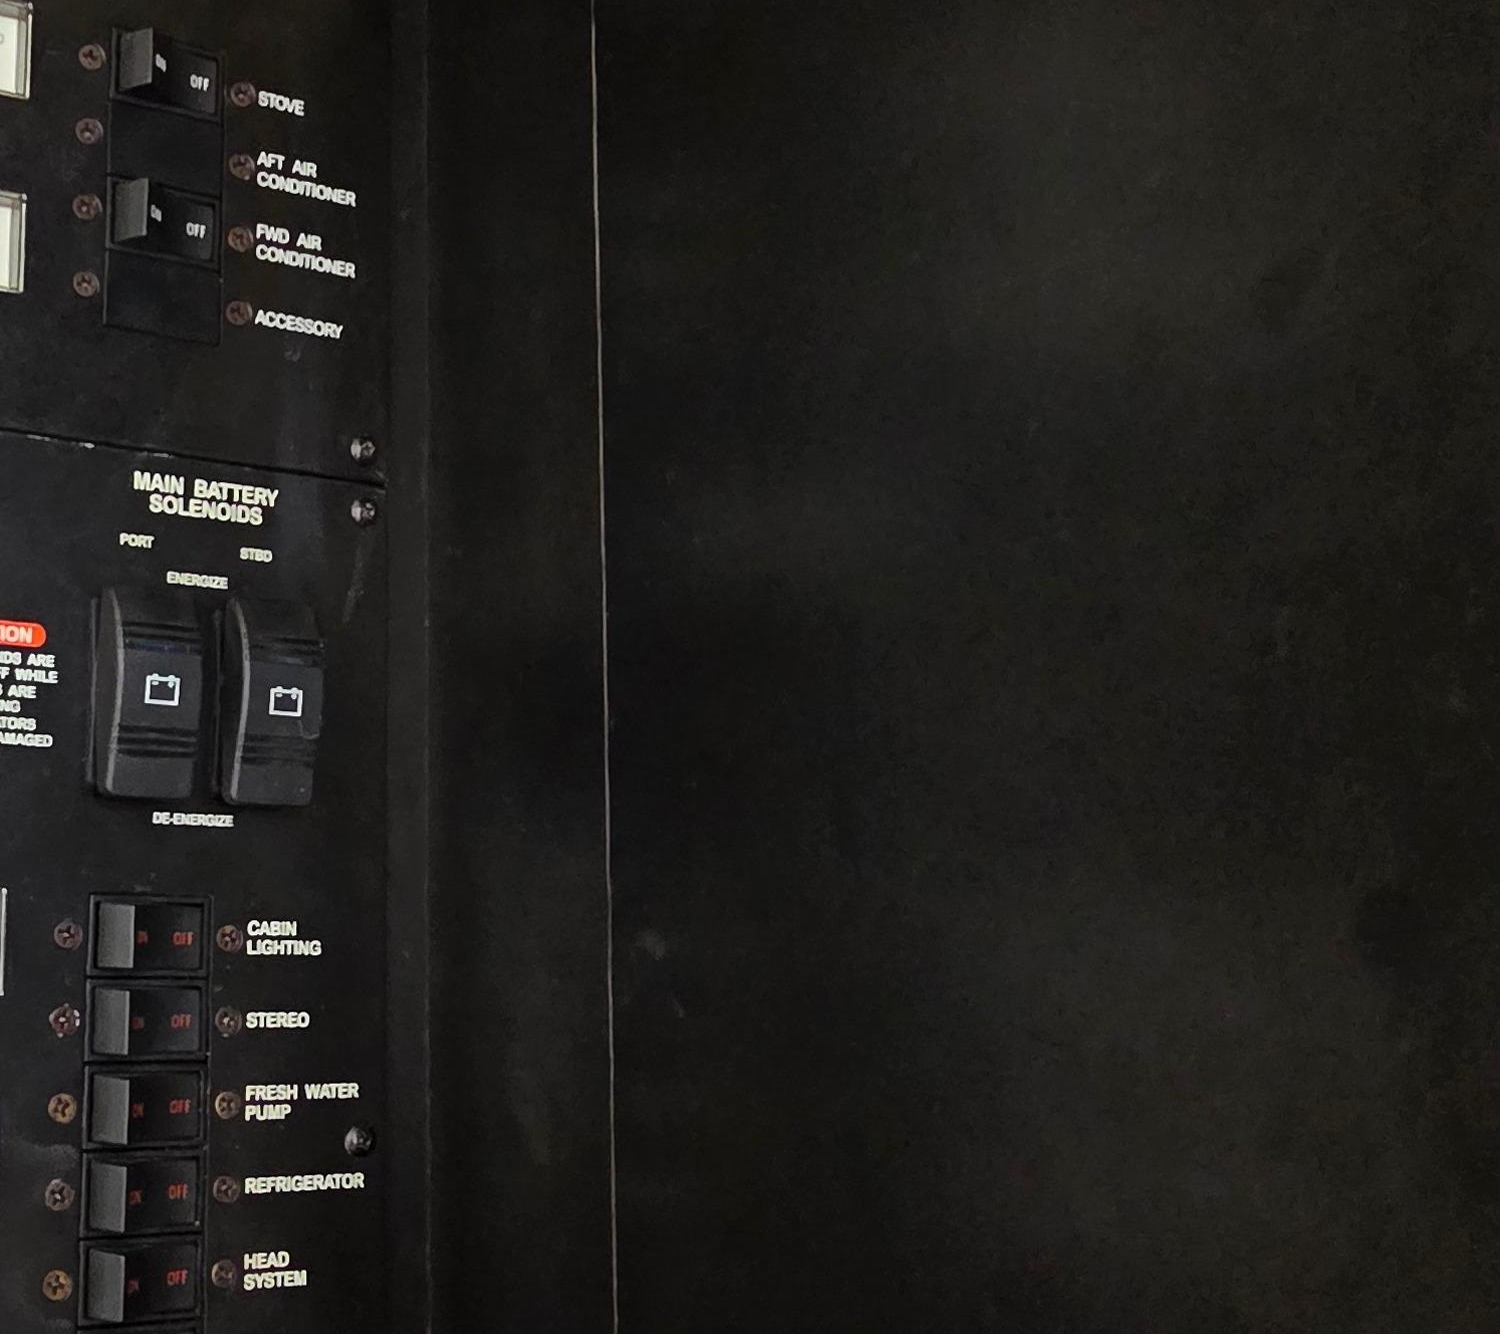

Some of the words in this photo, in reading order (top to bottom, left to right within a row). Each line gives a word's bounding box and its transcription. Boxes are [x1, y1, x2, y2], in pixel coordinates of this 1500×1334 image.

[258, 91, 304, 116] STOVE
[256, 152, 285, 170] AFT
[292, 160, 317, 178] AIR
[257, 172, 356, 207] CONDITIONER
[255, 224, 289, 244] FWD
[296, 233, 321, 251] AIR
[256, 245, 355, 278] CONDITIONER
[254, 310, 343, 339] ACCESSORY
[134, 471, 184, 498] MAIN
[194, 479, 278, 507] BATTERY
[149, 494, 262, 525] SOLENOIDS
[120, 533, 154, 548] PORT
[240, 547, 272, 562] STBD
[167, 571, 228, 589] ENERGIZE
[152, 812, 234, 827] DE-ENERGIZE
[247, 920, 297, 936] CABIN
[247, 939, 321, 955] LIGHTING
[246, 1012, 309, 1028] STEREO
[246, 1084, 298, 1101] FRESH
[305, 1083, 359, 1099] WATER
[245, 1104, 291, 1121] PUMP
[245, 1172, 364, 1194] REFRIGERATOR
[244, 1251, 289, 1270] HEAD
[244, 1270, 306, 1290] SYSTEM
